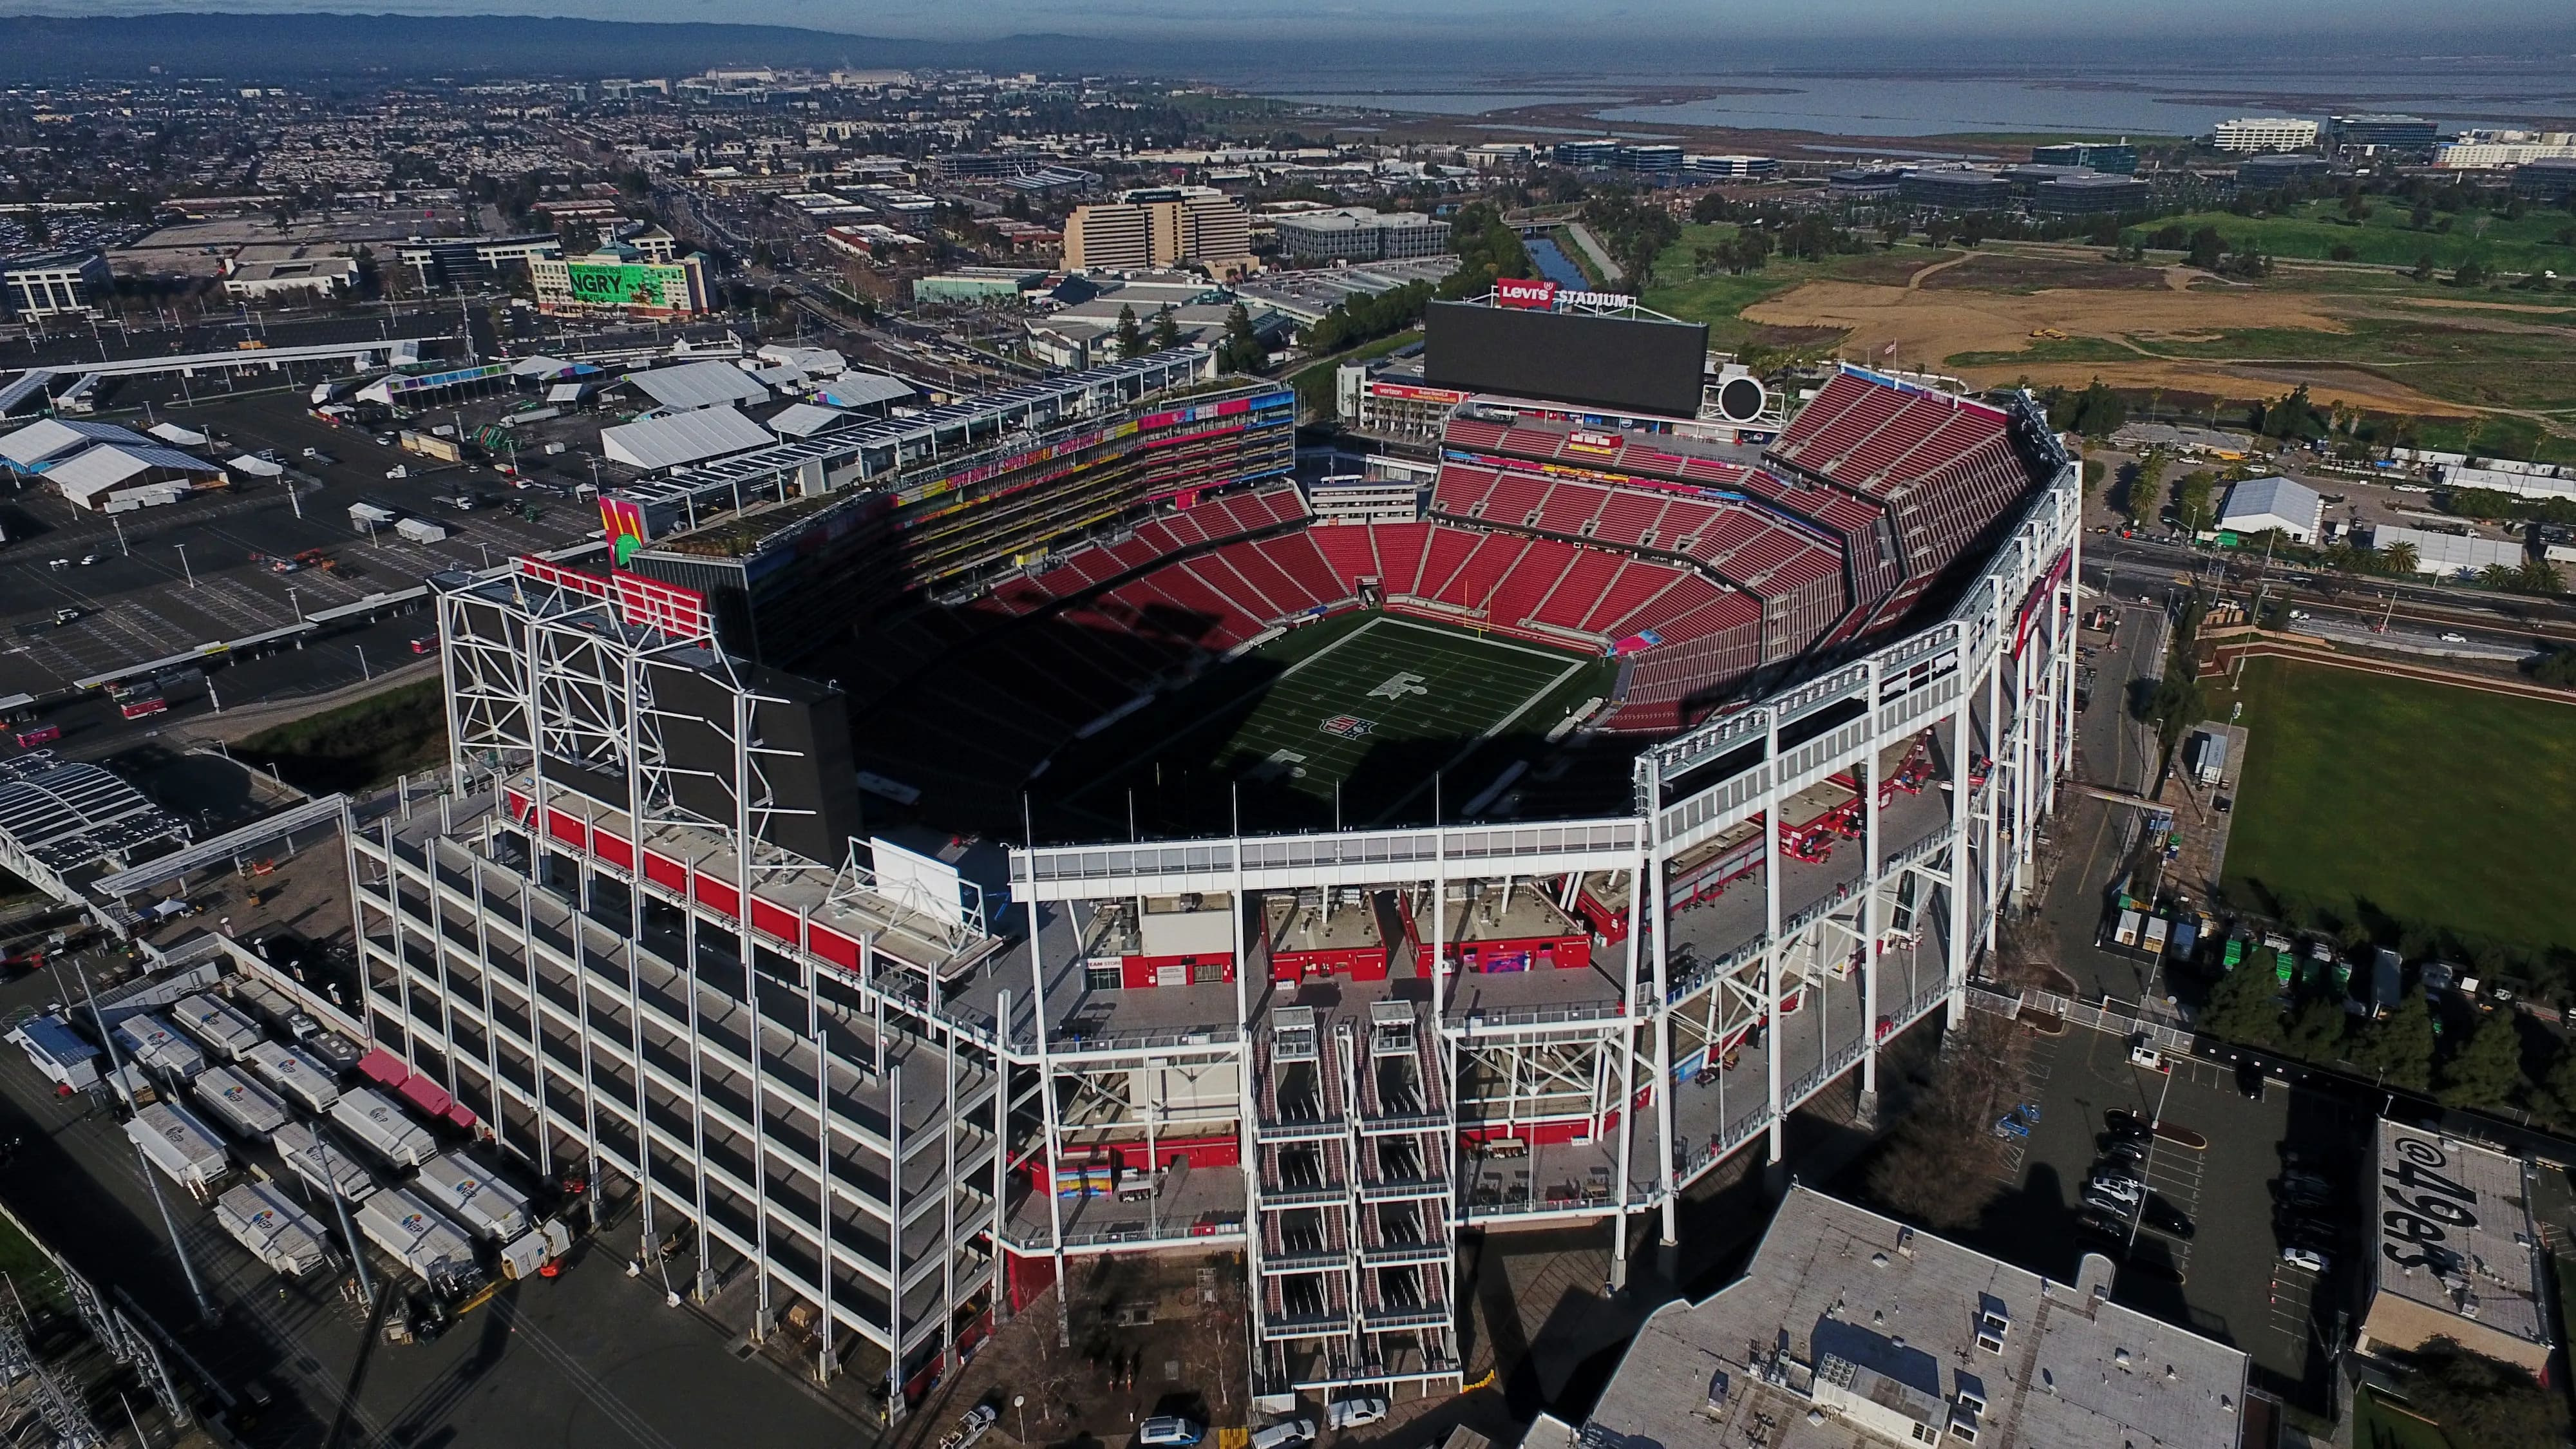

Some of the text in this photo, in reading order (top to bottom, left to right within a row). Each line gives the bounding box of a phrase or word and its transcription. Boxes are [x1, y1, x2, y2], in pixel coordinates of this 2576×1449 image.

[569, 274, 621, 294] NGRY
[1559, 290, 1629, 307] STADIUM
[1058, 430, 1104, 455] SUPER BOWL LX
[1003, 455, 1024, 471] SUPER
[1044, 446, 1053, 459] LX
[945, 474, 969, 490] SUPER
[971, 468, 990, 482] BOWL
[461, 1184, 477, 1197] NEP
[2382, 1137, 2478, 1278] @49ers
[258, 1217, 273, 1229] NEP
[408, 1220, 424, 1233] NEP
